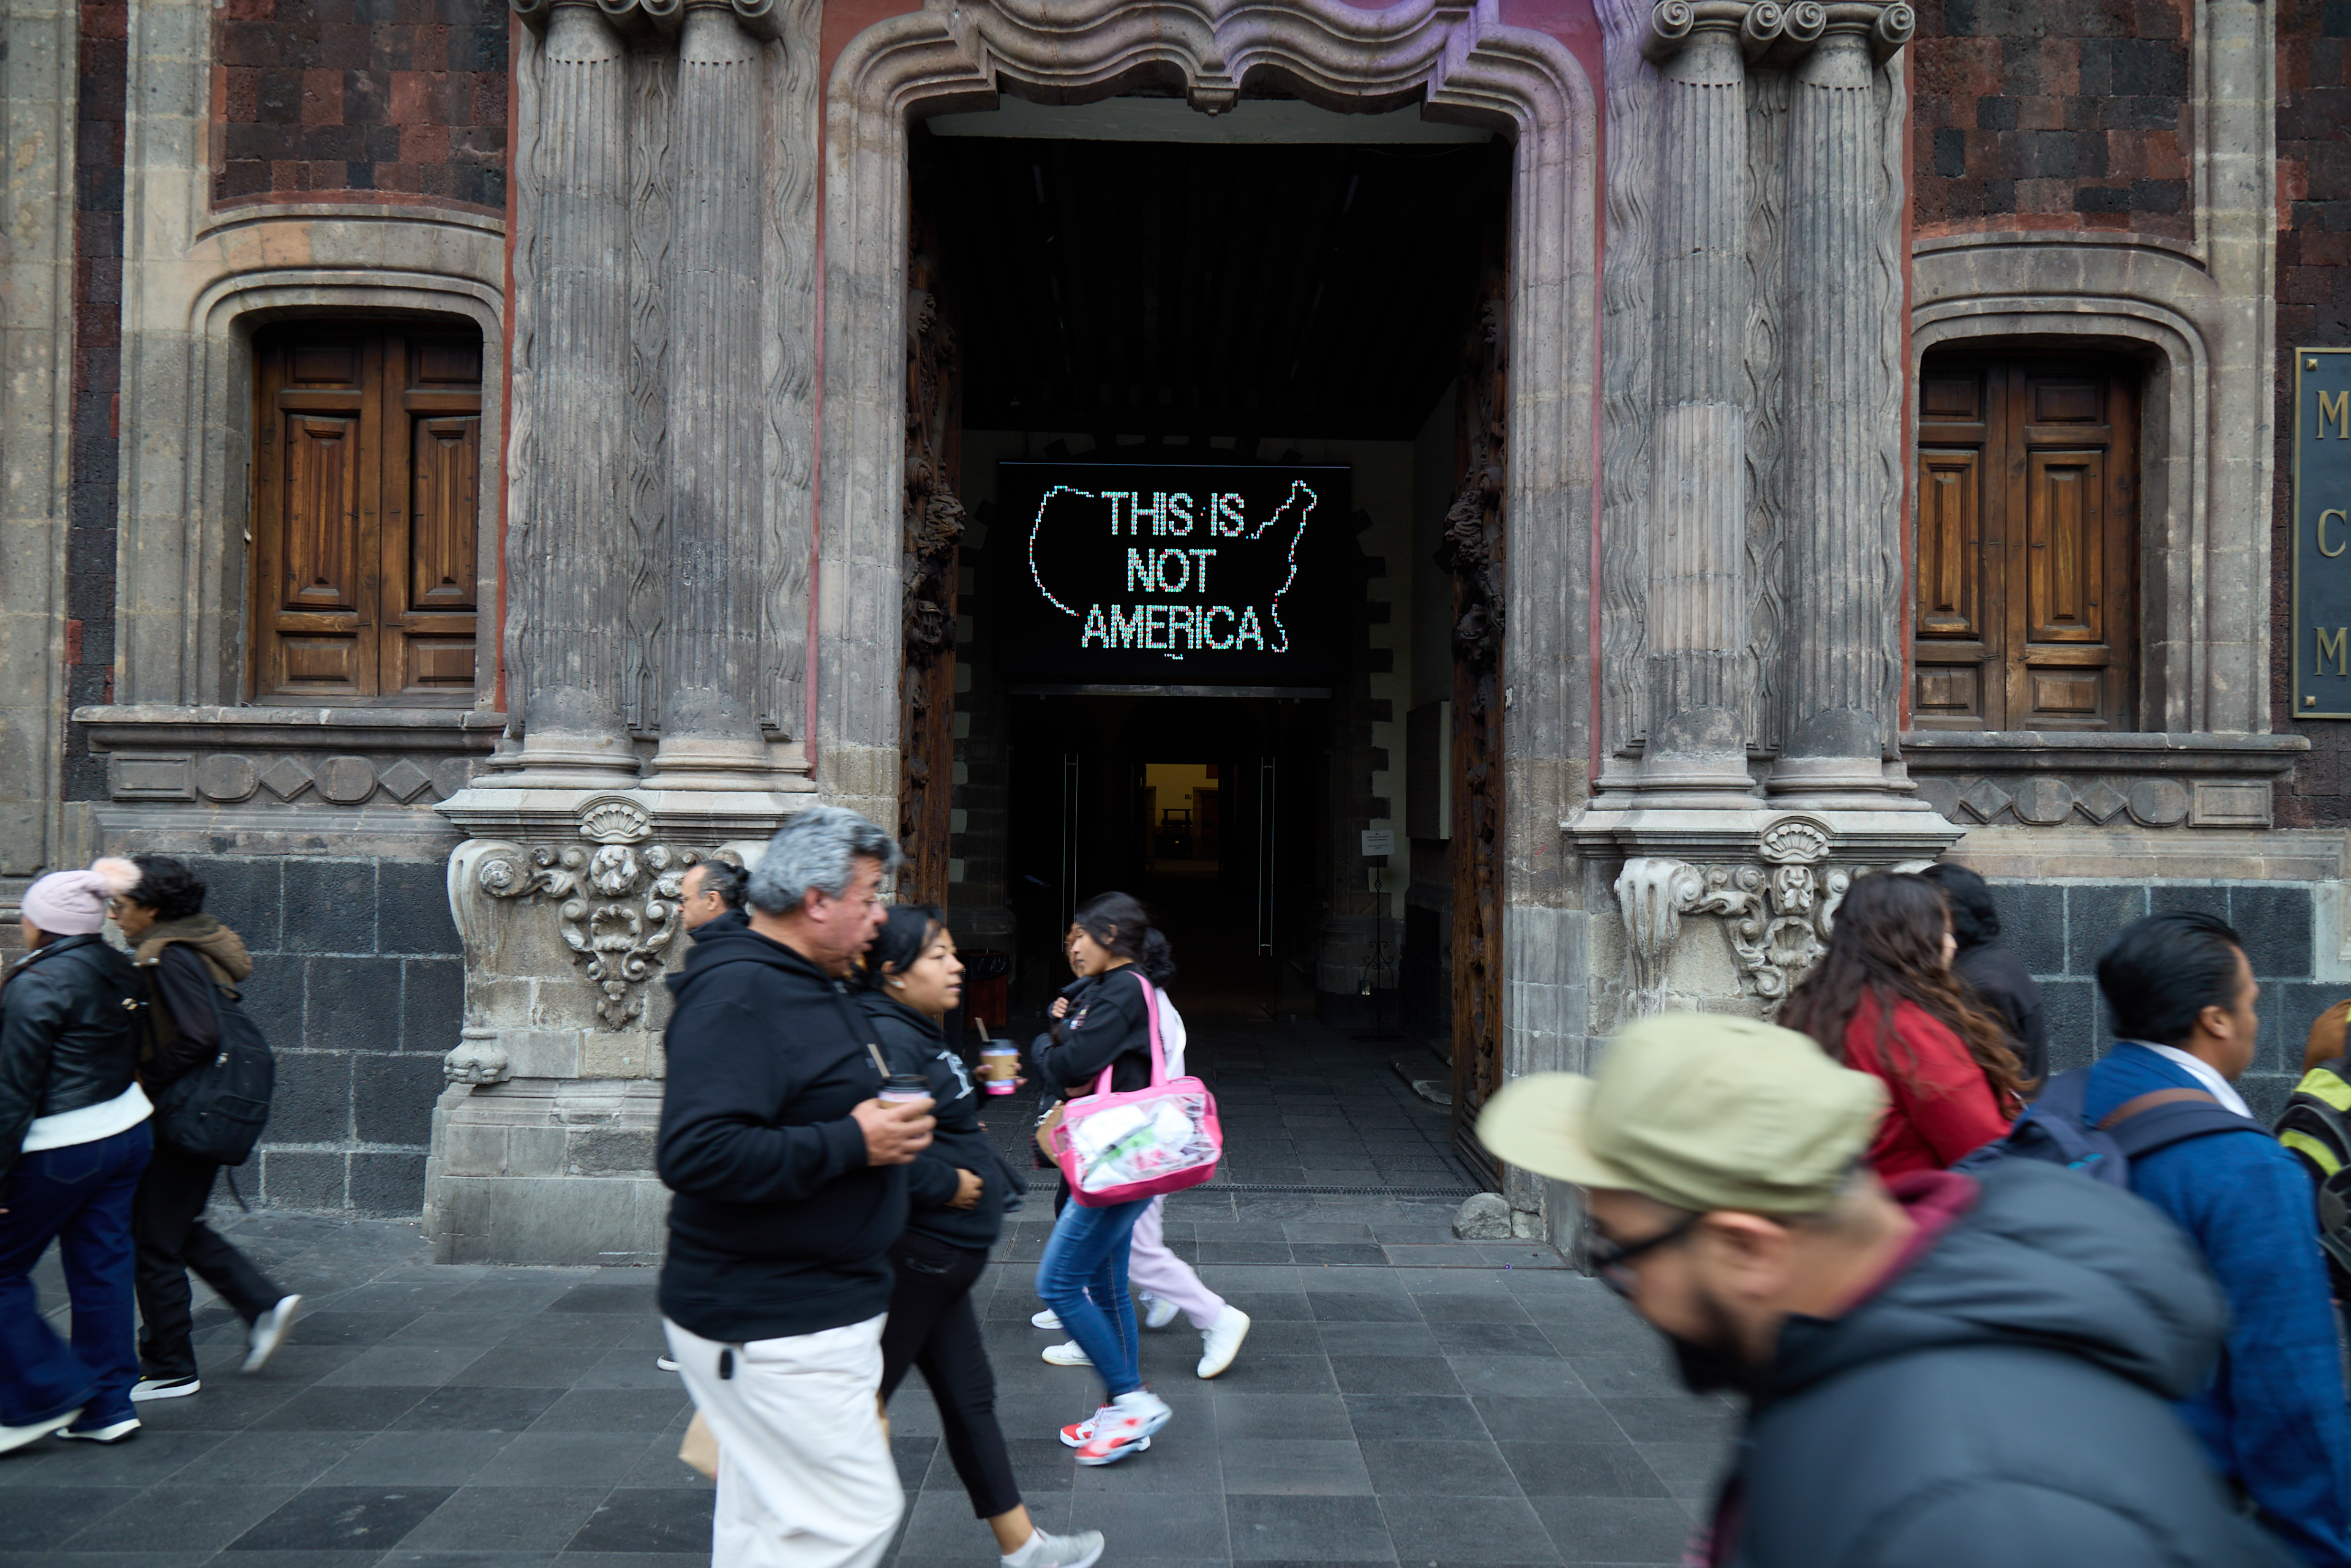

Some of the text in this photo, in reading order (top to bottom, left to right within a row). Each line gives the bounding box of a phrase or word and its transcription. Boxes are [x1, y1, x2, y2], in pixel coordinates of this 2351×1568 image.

[1101, 490, 1245, 537] THIS IS
[1127, 547, 1217, 593] NOT
[1081, 603, 1264, 650] AMERICA
